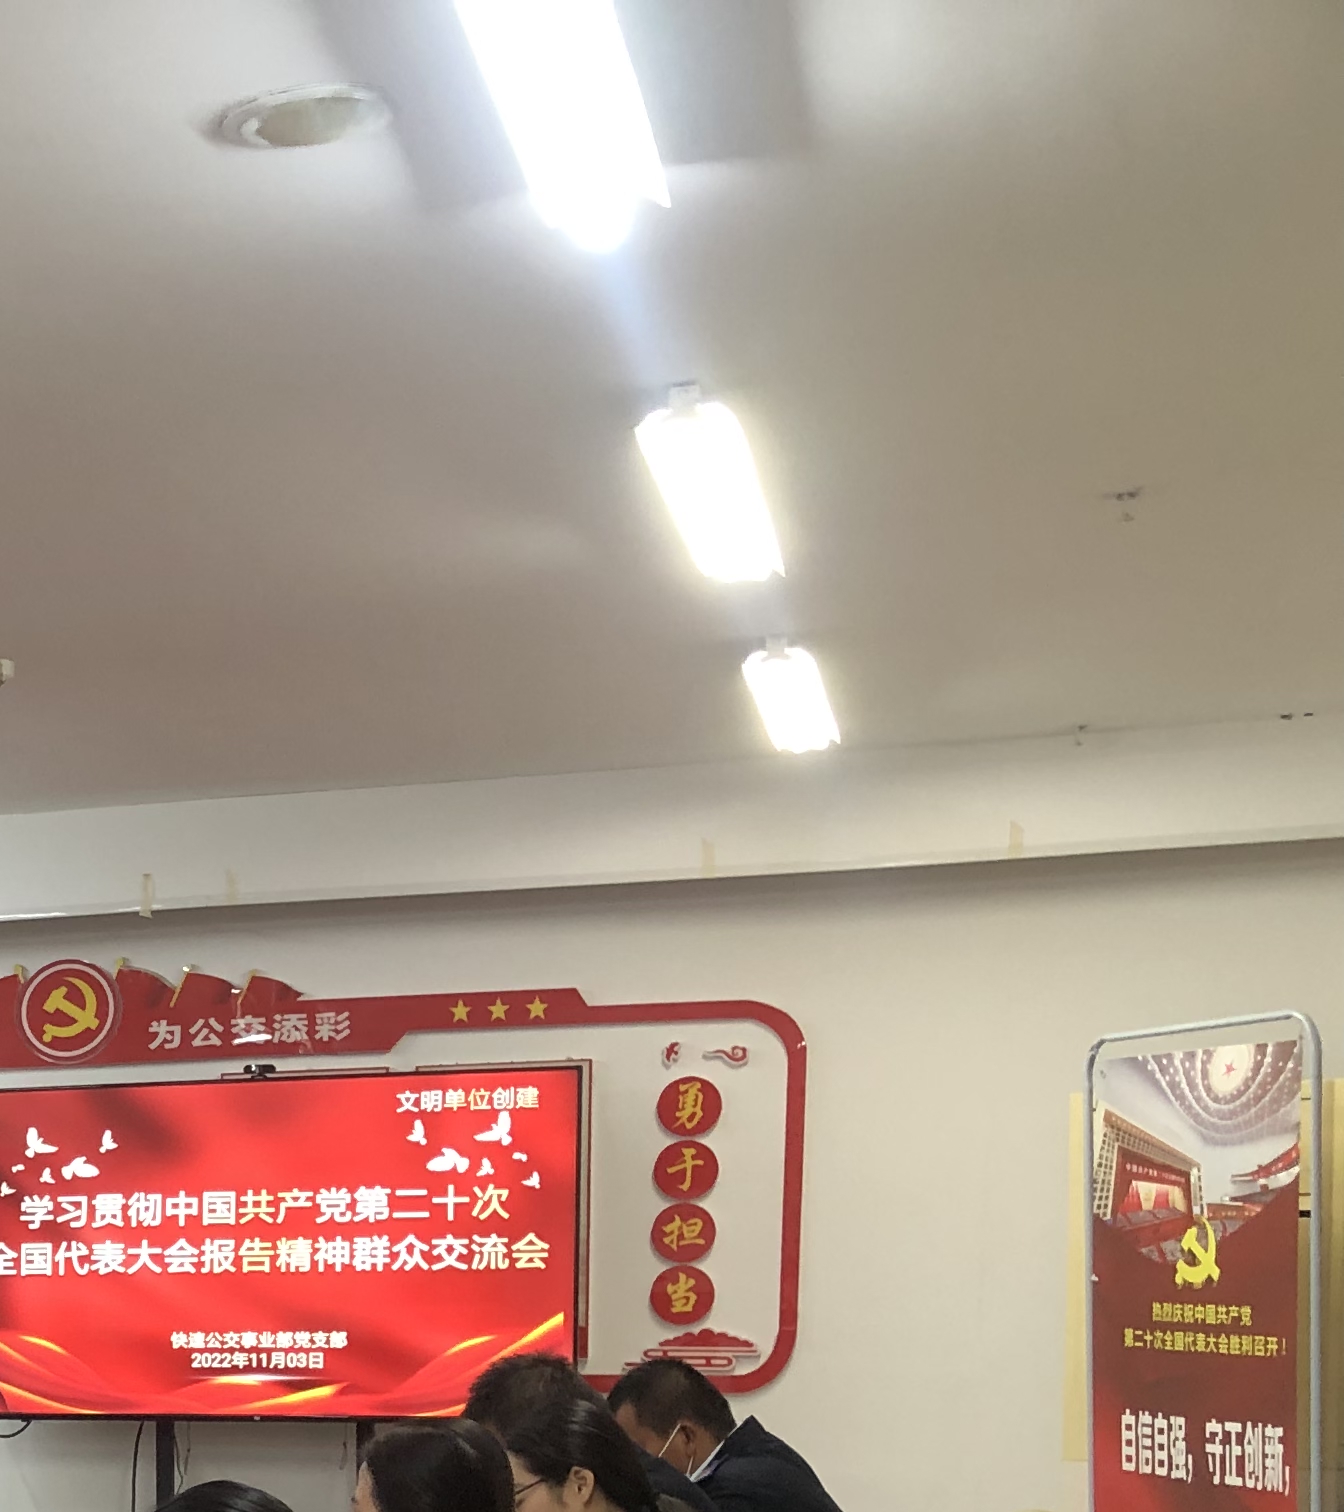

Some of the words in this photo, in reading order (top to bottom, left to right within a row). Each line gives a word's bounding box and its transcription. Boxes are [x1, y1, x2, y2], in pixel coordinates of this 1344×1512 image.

[149, 1012, 351, 1050] 为公交添彩
[396, 1086, 539, 1113] 文明单位创建
[19, 1184, 510, 1229] 学习贯彻中国共产党第二十次
[662, 1081, 705, 1313] 勇于担当
[1152, 1301, 1252, 1326] 热烈庆祝中国共产党
[170, 1331, 348, 1348] 快速公交事业部党支部
[191, 1352, 324, 1369] 2022年11月03日
